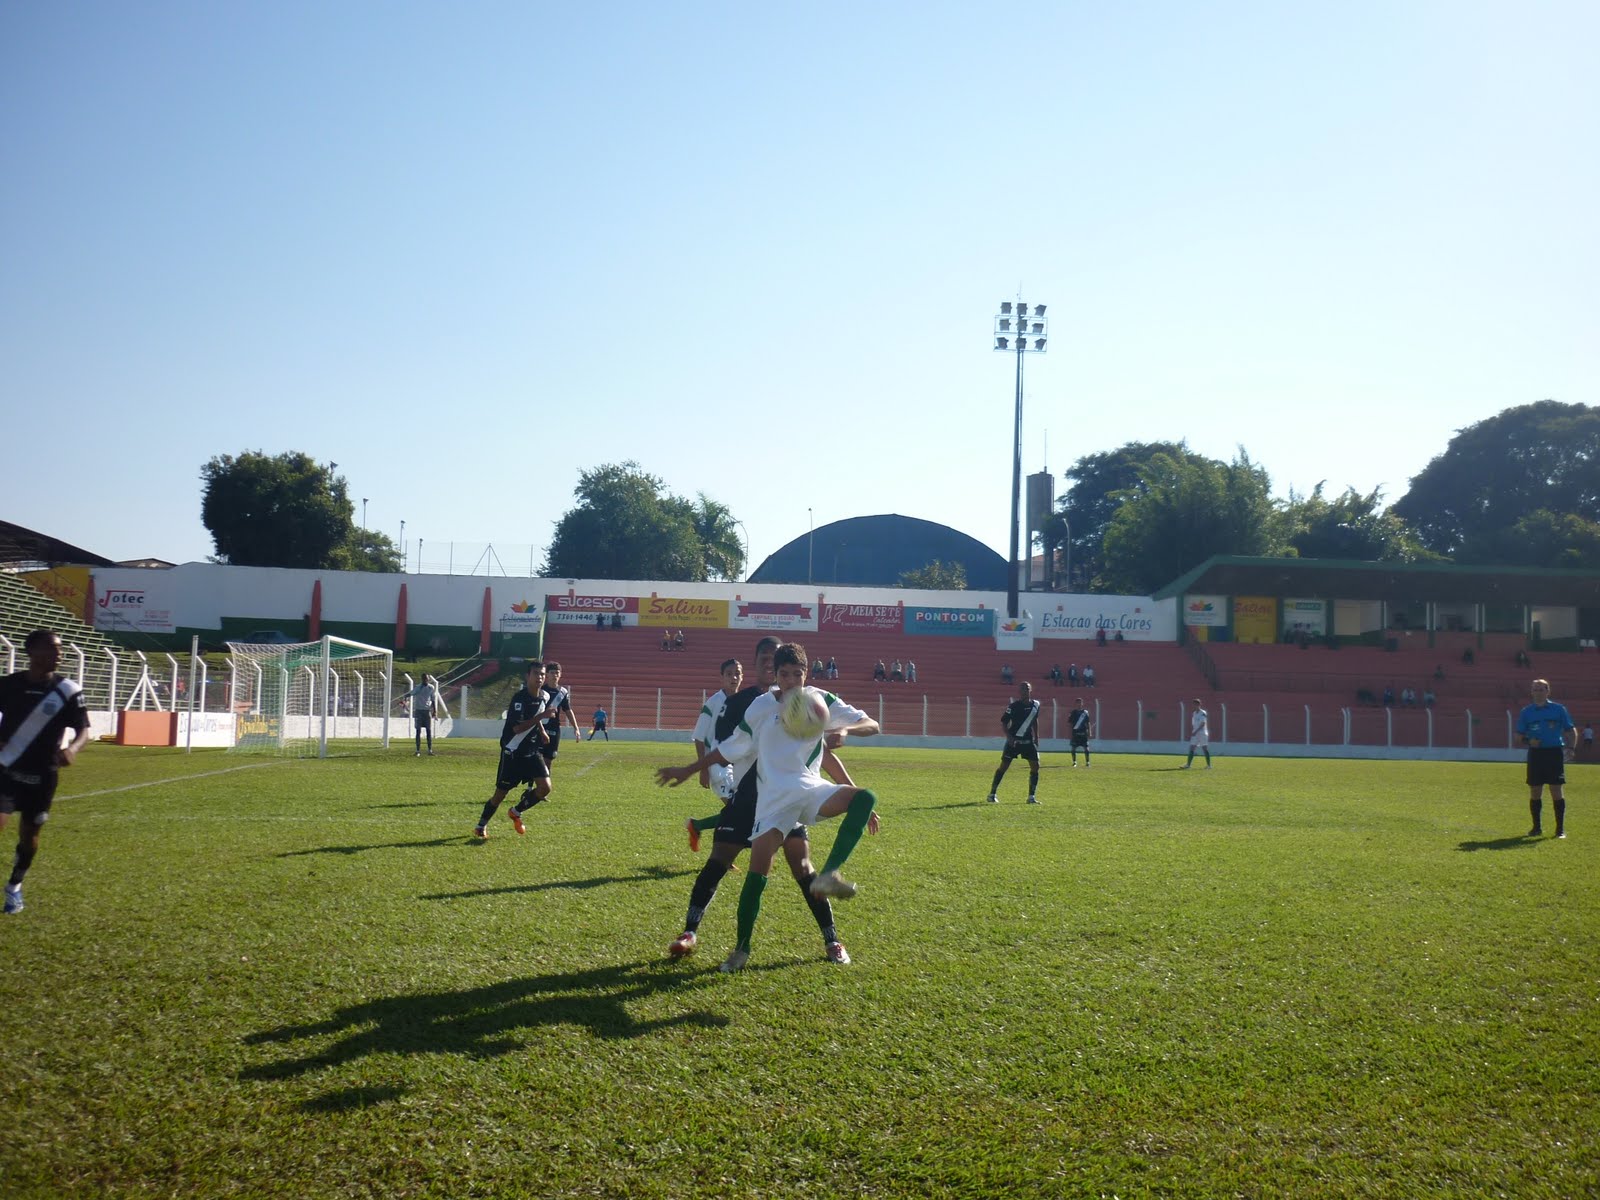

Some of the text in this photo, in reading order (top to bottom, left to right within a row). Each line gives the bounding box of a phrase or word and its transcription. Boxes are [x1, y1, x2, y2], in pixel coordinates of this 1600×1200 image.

[99, 590, 144, 607] Jotec
[558, 597, 626, 610] sucesso
[849, 606, 873, 616] MEIA
[915, 612, 985, 622] PONTOCOM
[1095, 614, 1117, 629] das
[1120, 614, 1152, 631] Cores
[720, 785, 726, 793] 7
